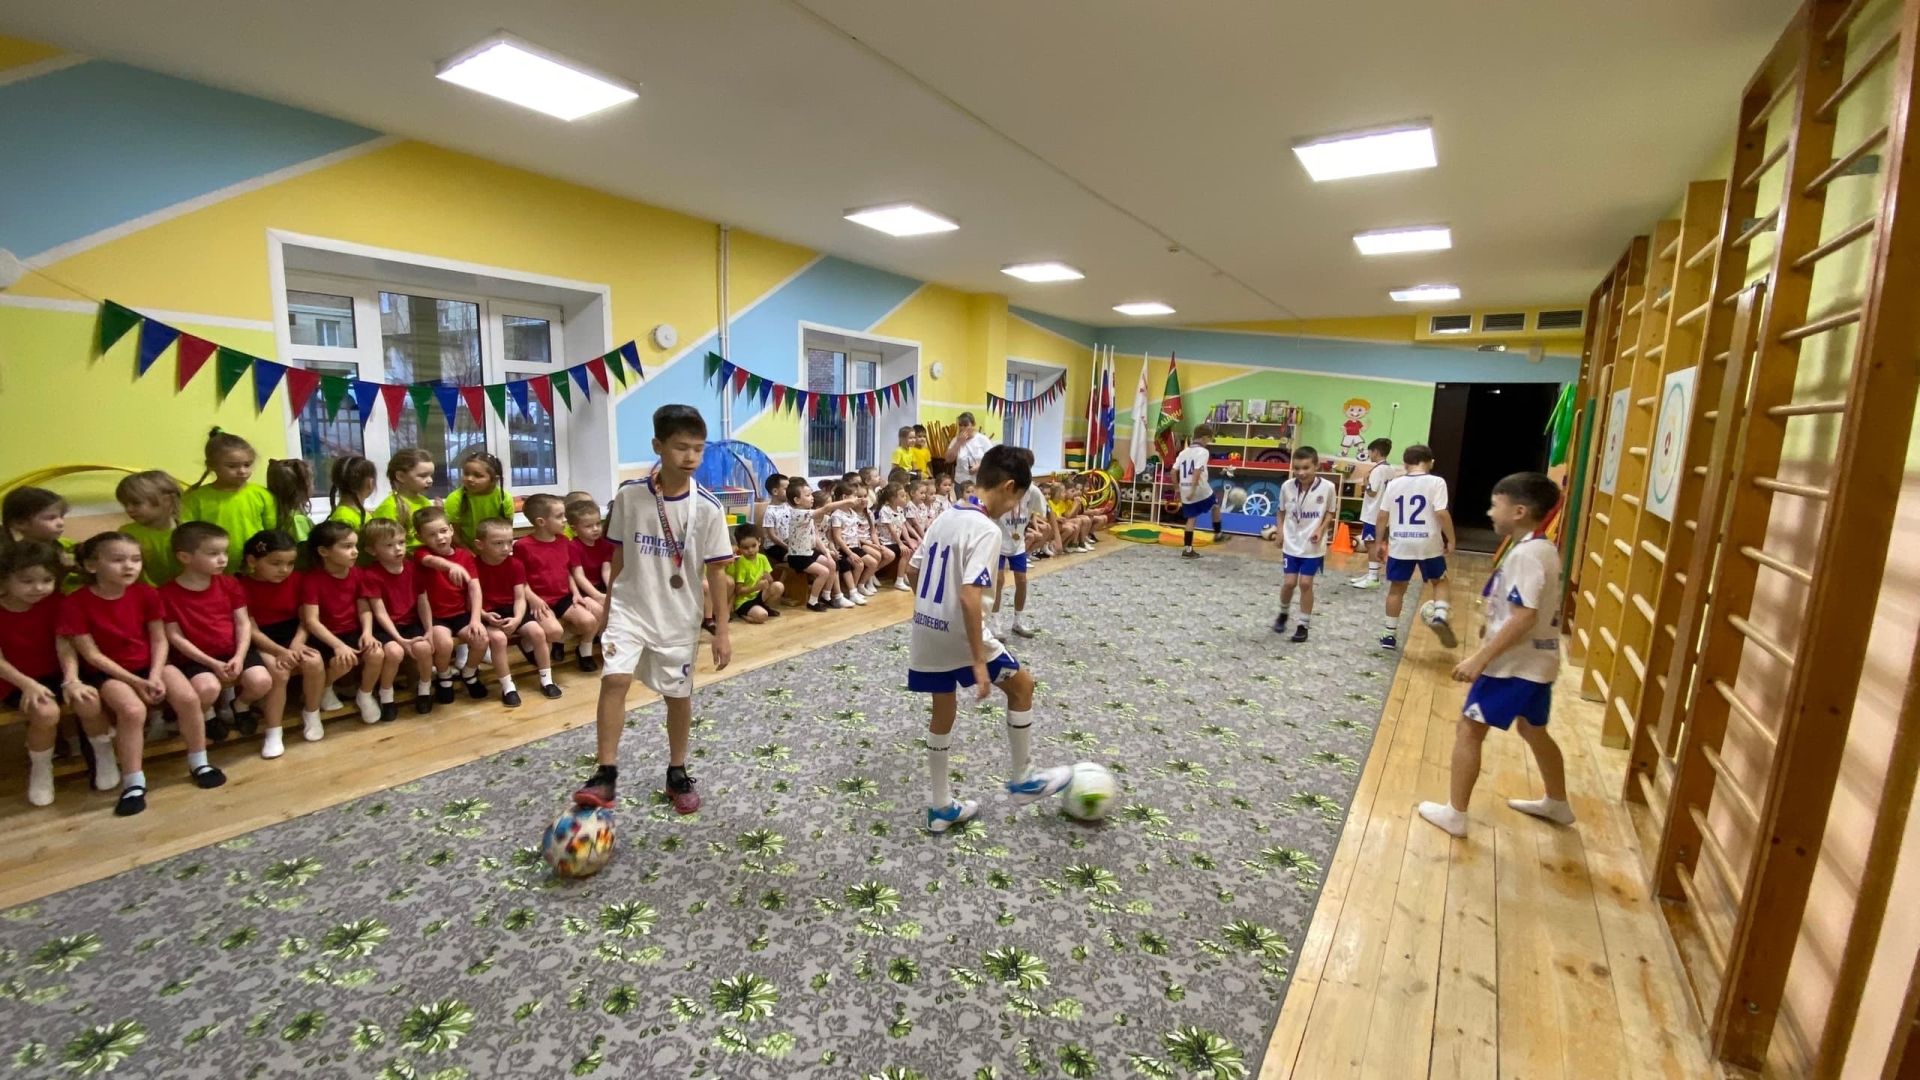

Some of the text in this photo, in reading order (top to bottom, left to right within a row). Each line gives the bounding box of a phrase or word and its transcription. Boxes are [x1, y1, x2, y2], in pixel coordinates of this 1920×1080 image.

[1182, 459, 1195, 478] 14
[1394, 494, 1427, 525] 12
[634, 532, 685, 550] Emiraes
[640, 545, 673, 558] FLY BETTE
[920, 542, 950, 604] 11
[914, 611, 950, 632] ДЕЛЕЕВСК
